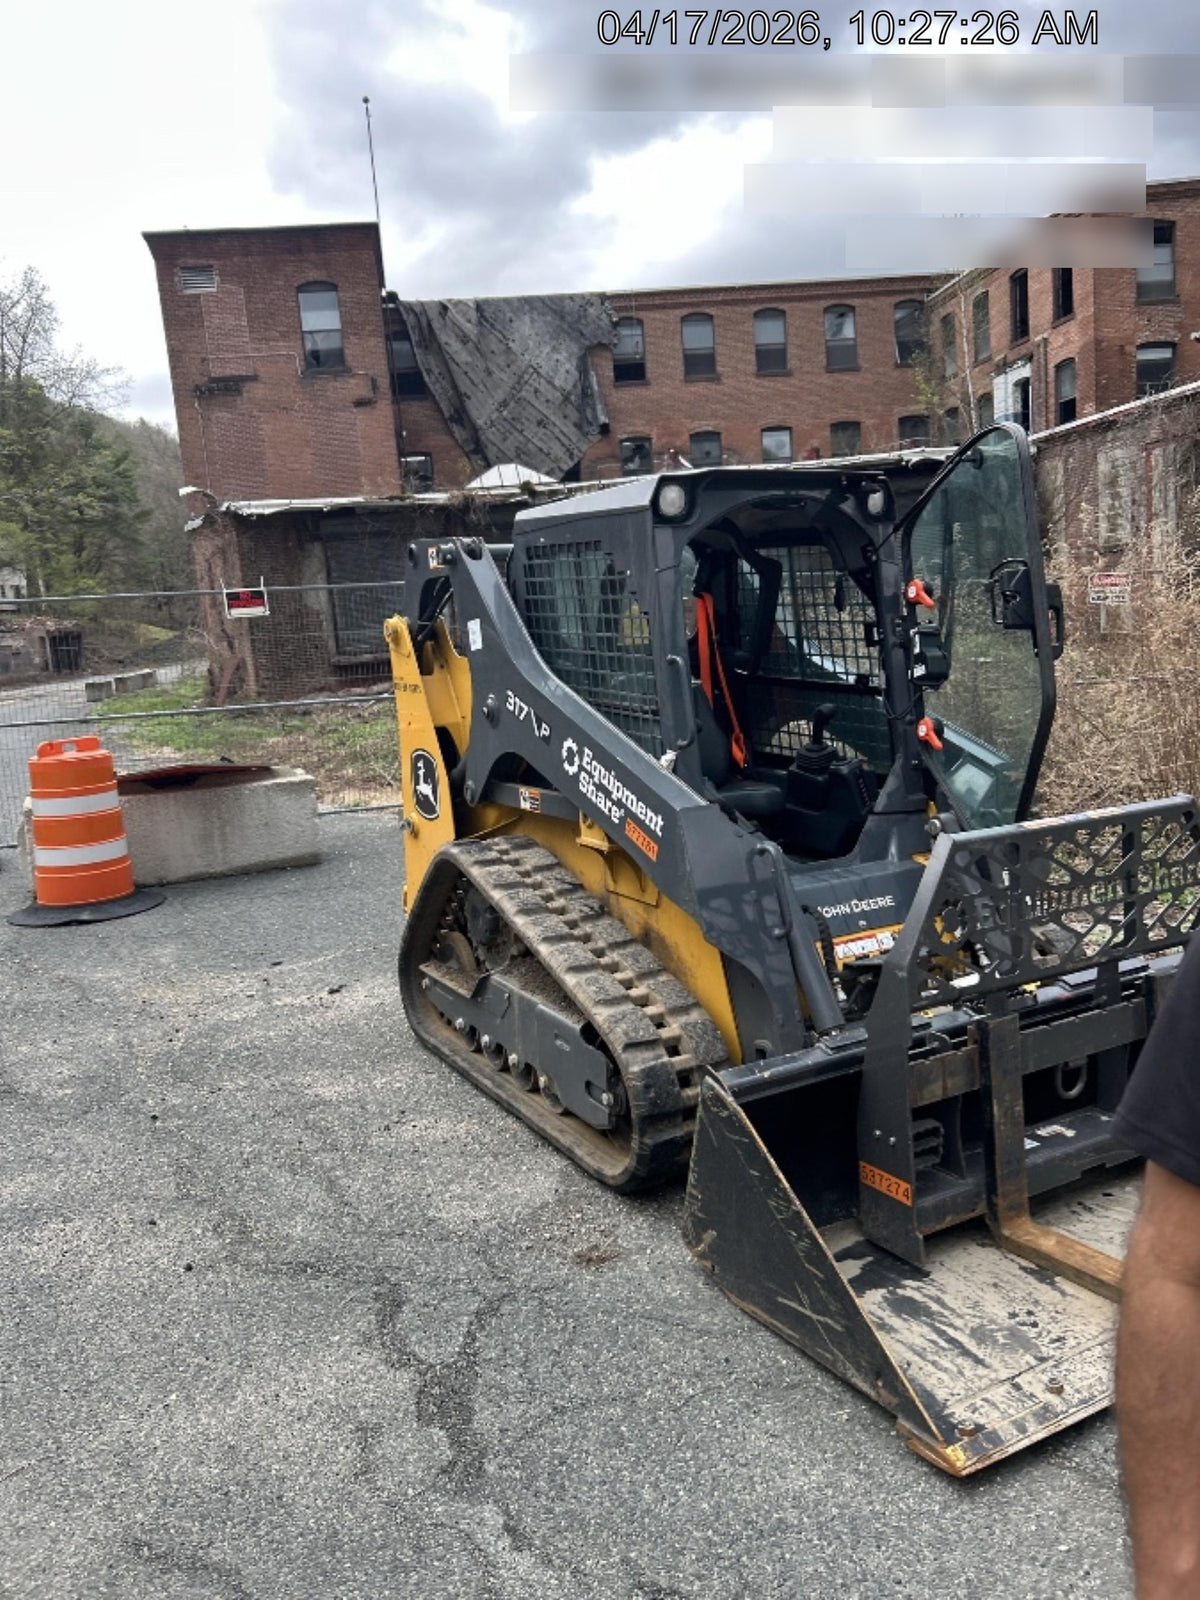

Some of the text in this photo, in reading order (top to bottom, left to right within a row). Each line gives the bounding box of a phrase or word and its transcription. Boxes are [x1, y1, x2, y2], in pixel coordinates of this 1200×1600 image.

[582, 747, 664, 838] Equipment
[818, 895, 895, 918] OHN DEERE
